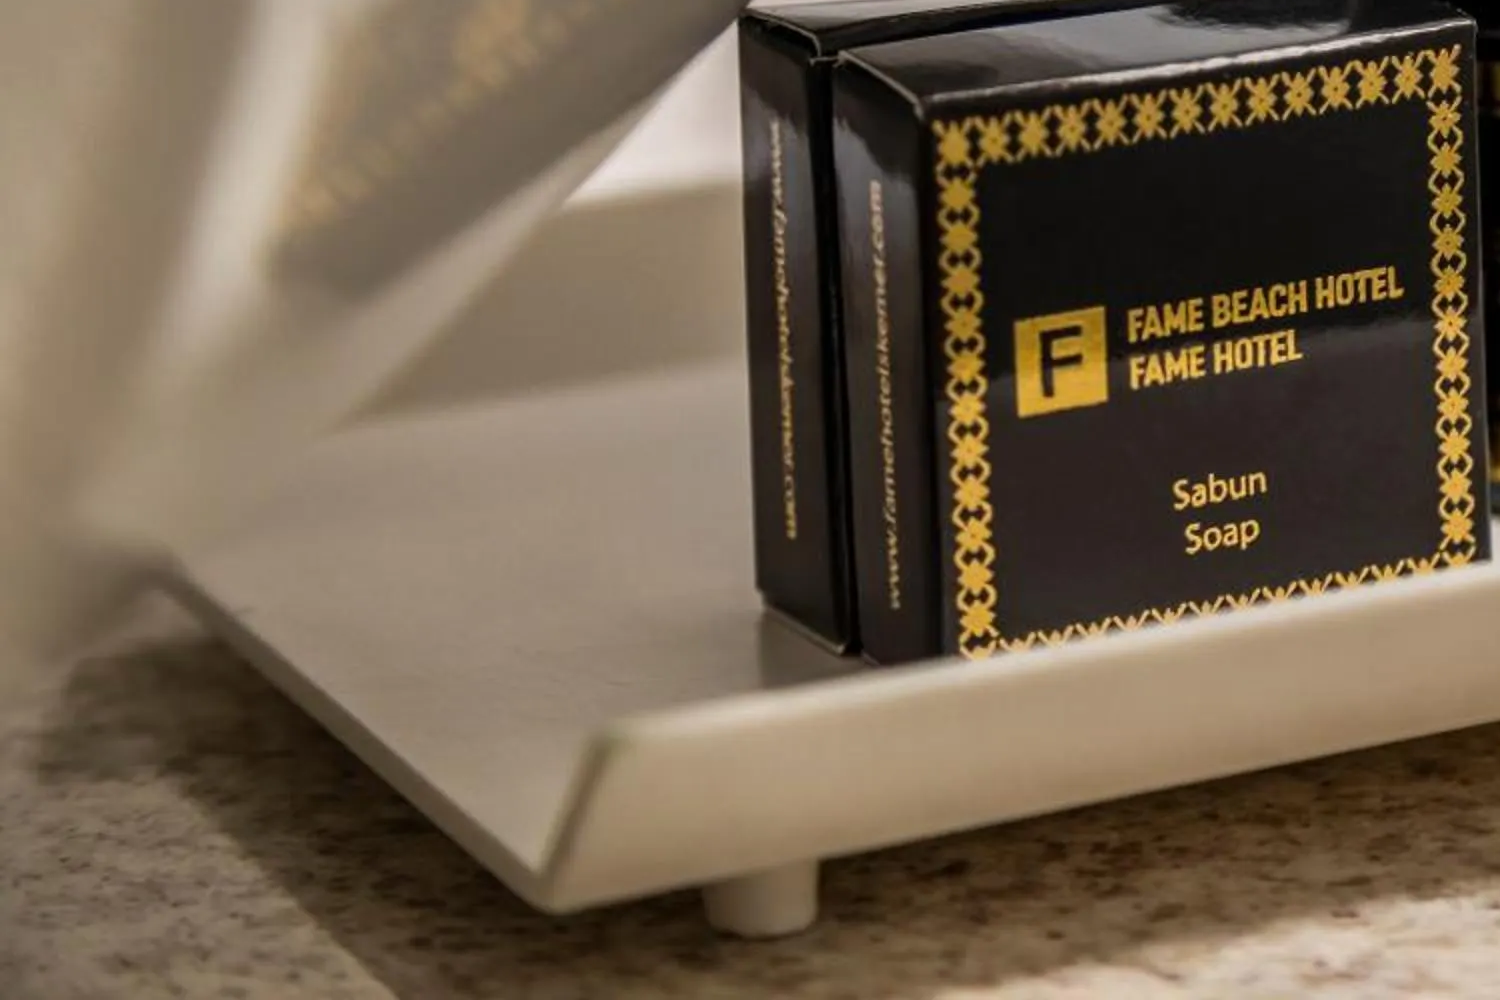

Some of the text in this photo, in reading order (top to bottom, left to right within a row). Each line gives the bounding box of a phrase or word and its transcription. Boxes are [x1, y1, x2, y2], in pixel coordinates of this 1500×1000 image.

[1127, 265, 1405, 344] FAME BEACH HOTEL
[1129, 329, 1303, 391] FAME HOTEL
[869, 179, 901, 609] www.famehotelskemer.com
[1172, 471, 1267, 512] Sabun
[1184, 517, 1260, 555] Soap
